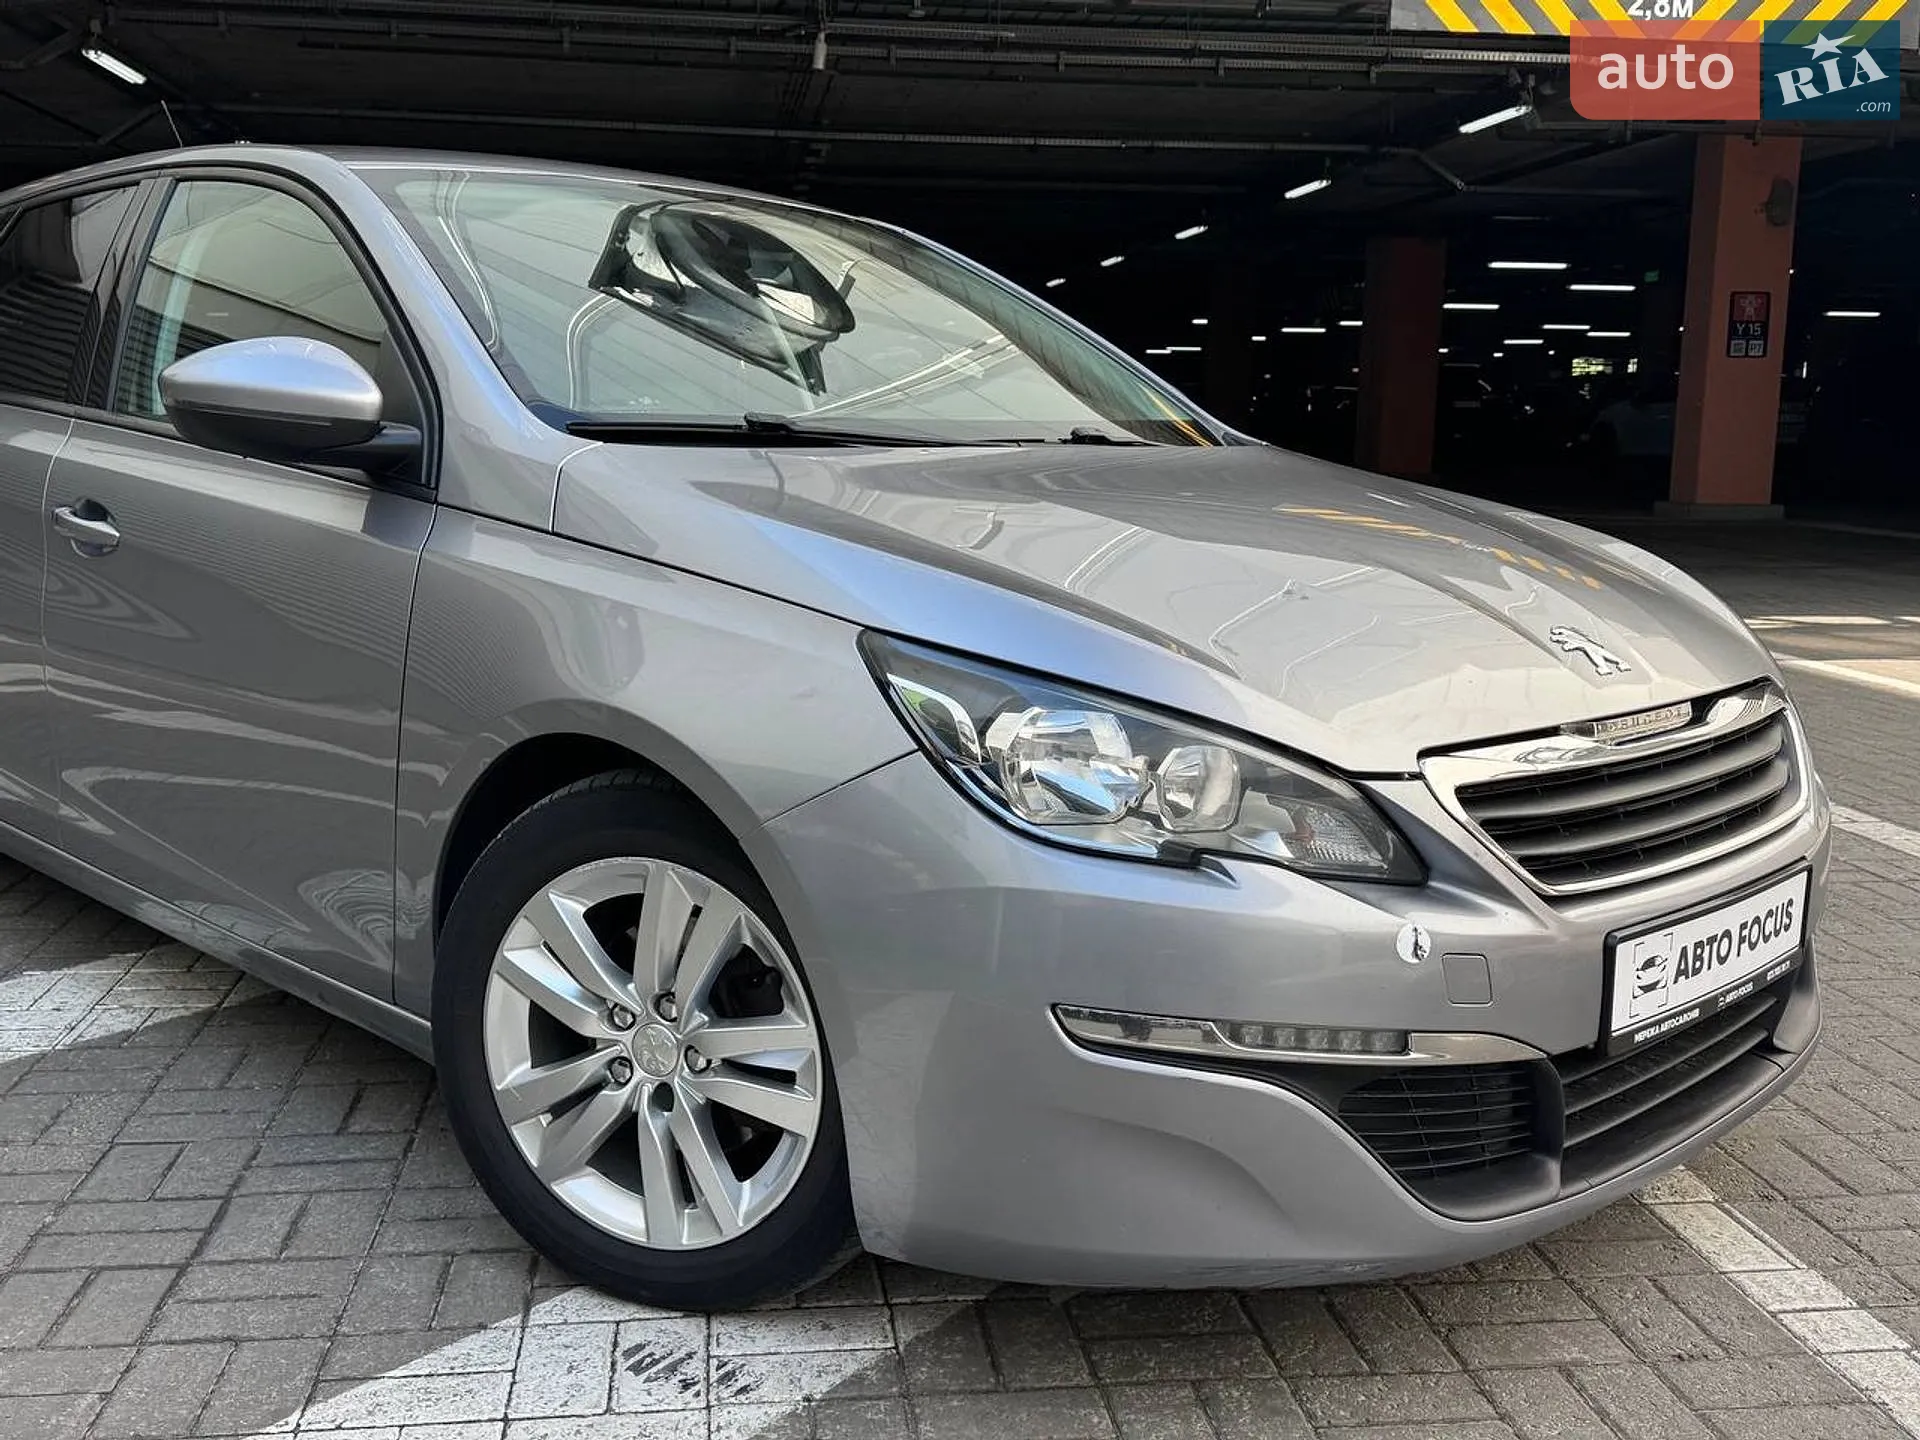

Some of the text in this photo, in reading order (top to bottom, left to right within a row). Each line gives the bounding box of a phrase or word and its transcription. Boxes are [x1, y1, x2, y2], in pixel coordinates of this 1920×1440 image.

[1736, 322, 1761, 336] Y 15
[1736, 897, 1794, 957] FOCUS
